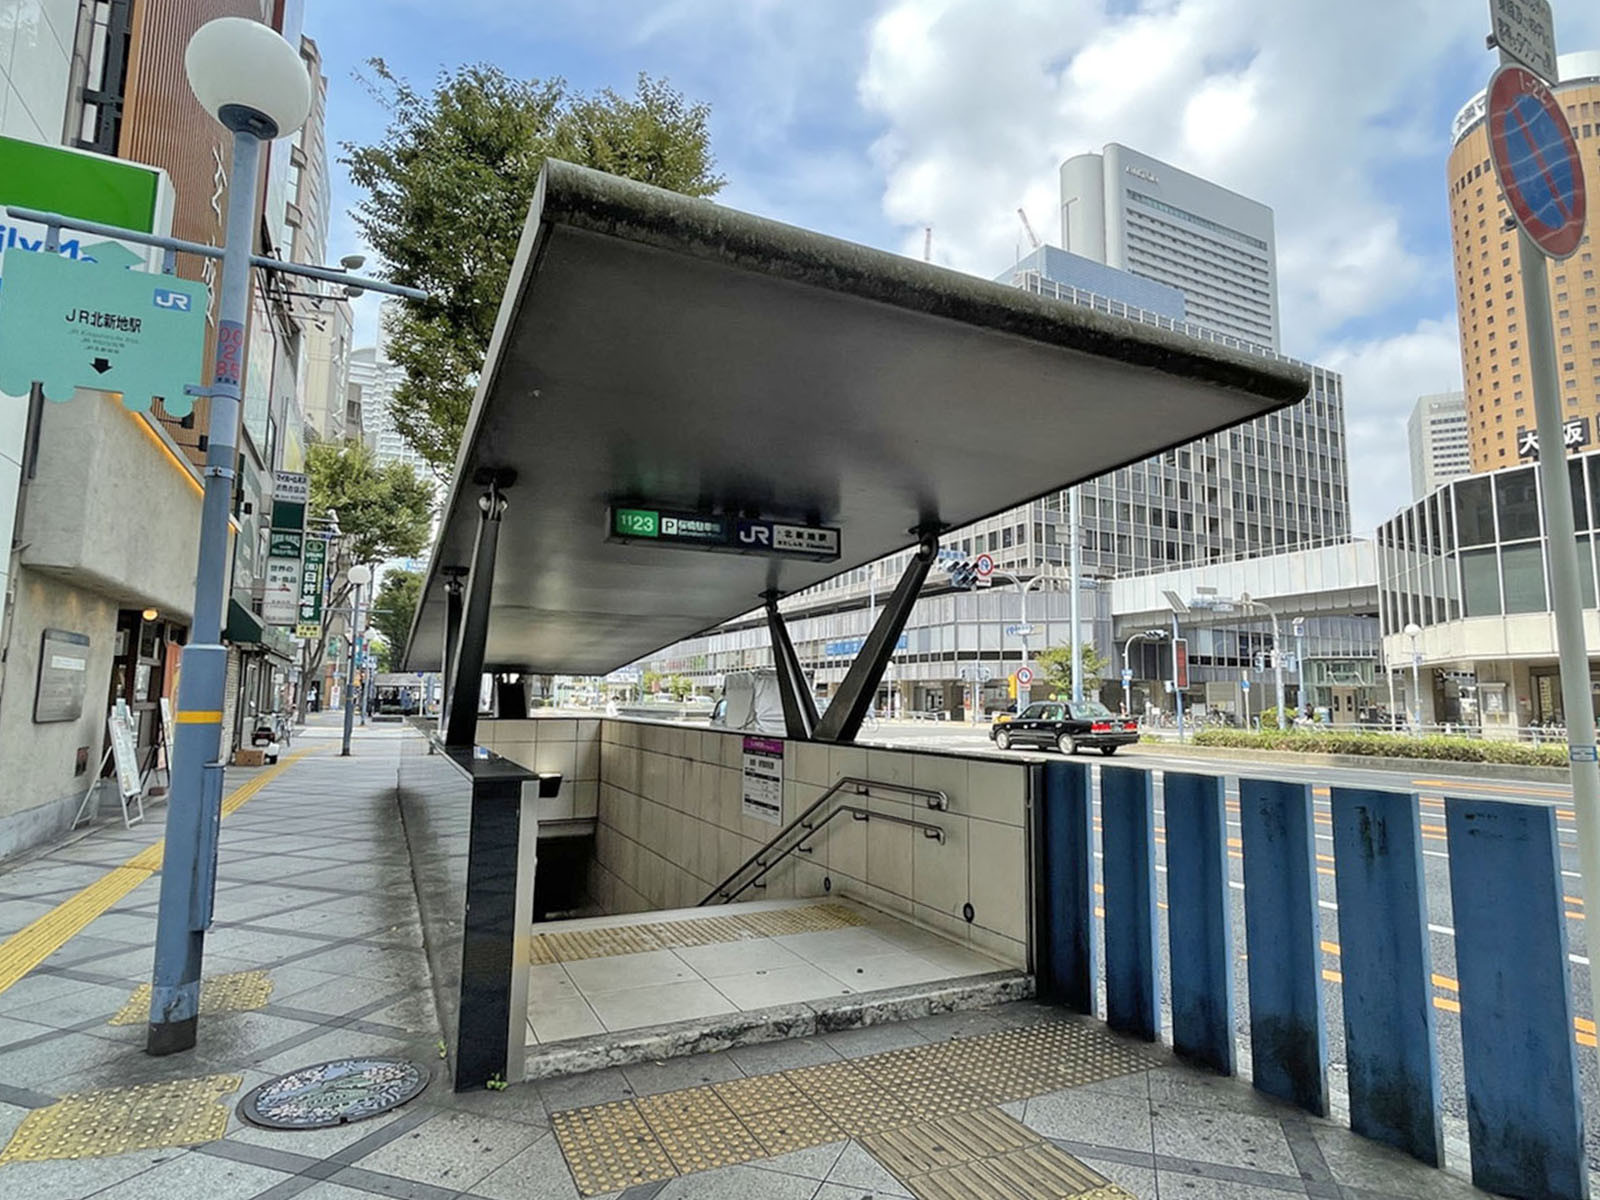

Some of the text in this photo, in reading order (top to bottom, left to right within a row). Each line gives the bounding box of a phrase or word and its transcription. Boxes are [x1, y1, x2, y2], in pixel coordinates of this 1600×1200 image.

[156, 293, 188, 310] JR
[65, 308, 142, 334] JR北新地駅
[665, 520, 675, 532] P
[739, 525, 770, 545] JR
